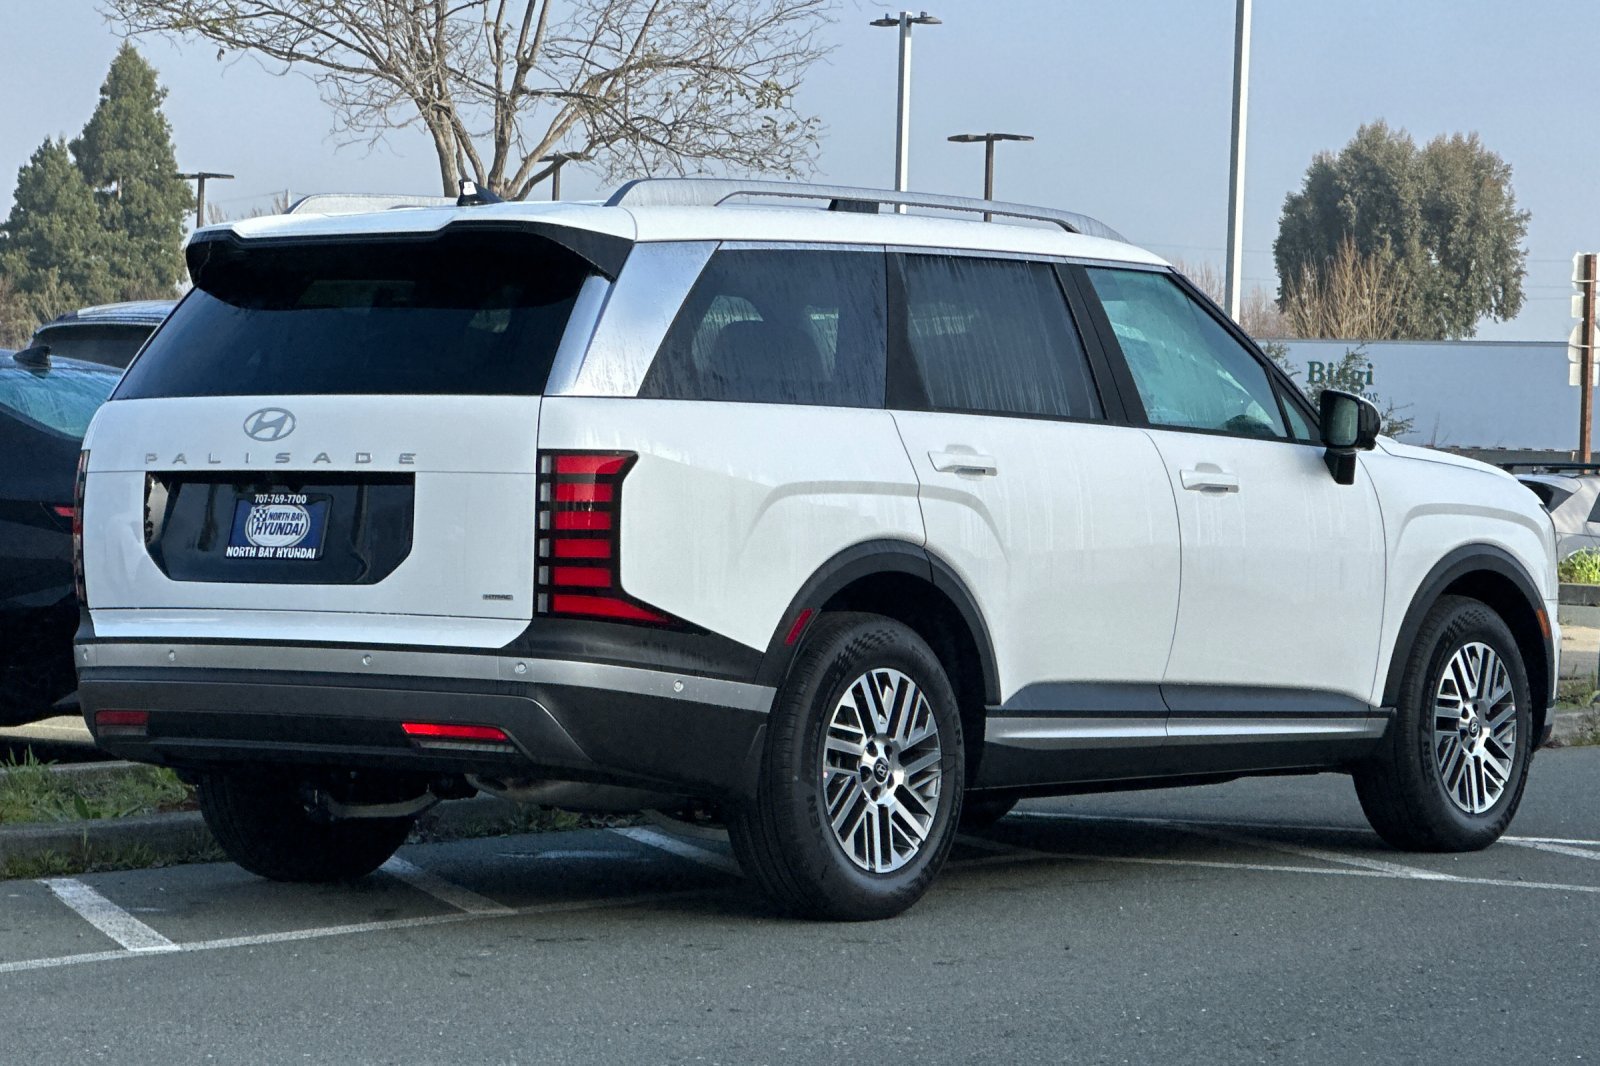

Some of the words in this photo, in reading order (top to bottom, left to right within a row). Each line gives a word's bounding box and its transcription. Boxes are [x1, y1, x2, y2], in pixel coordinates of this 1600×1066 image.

[145, 452, 416, 464] PALISADE
[255, 494, 307, 504] 707-769-7700
[267, 512, 290, 521] NORTH
[290, 512, 304, 521] BAY
[254, 522, 304, 536] HYUNDAI
[226, 546, 256, 557] NORTH
[258, 547, 275, 558] BAY
[276, 547, 316, 559] HYUNDAI
